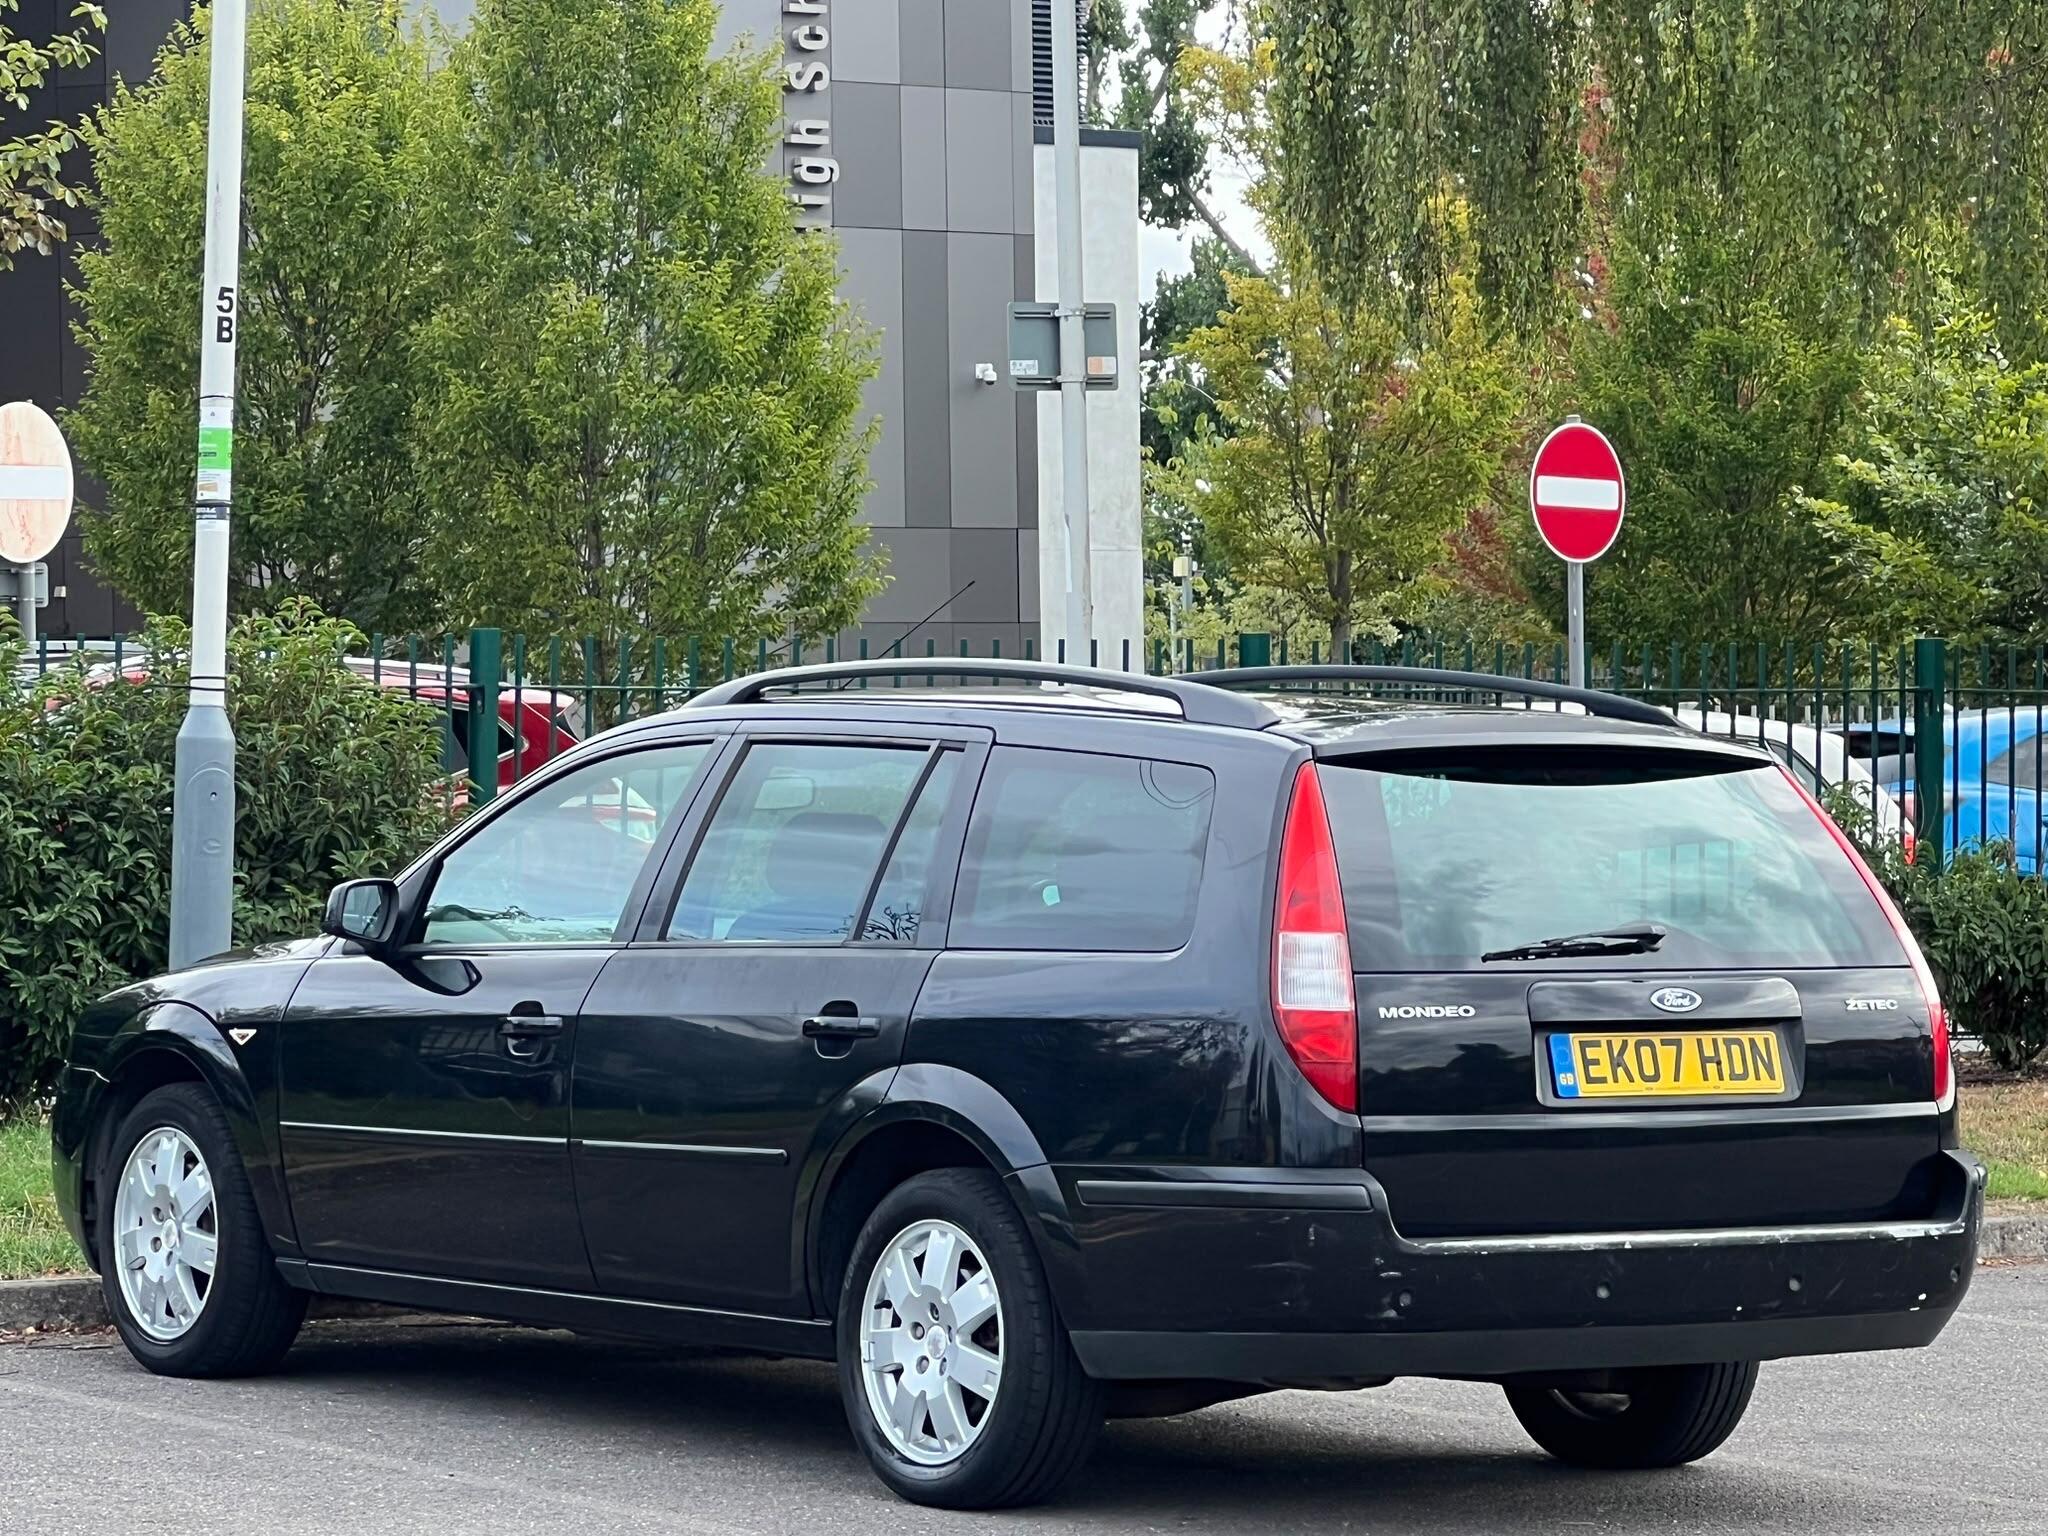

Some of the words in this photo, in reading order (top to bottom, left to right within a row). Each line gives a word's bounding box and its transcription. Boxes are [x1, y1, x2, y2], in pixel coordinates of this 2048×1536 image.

[790, 118, 839, 206] igh
[1378, 1005, 1476, 1019] MONDEO
[1844, 999, 1899, 1011] ZETEC
[1578, 1037, 1683, 1085] EK07
[1696, 1036, 1777, 1082] HDN
[1559, 1072, 1575, 1086] GB
